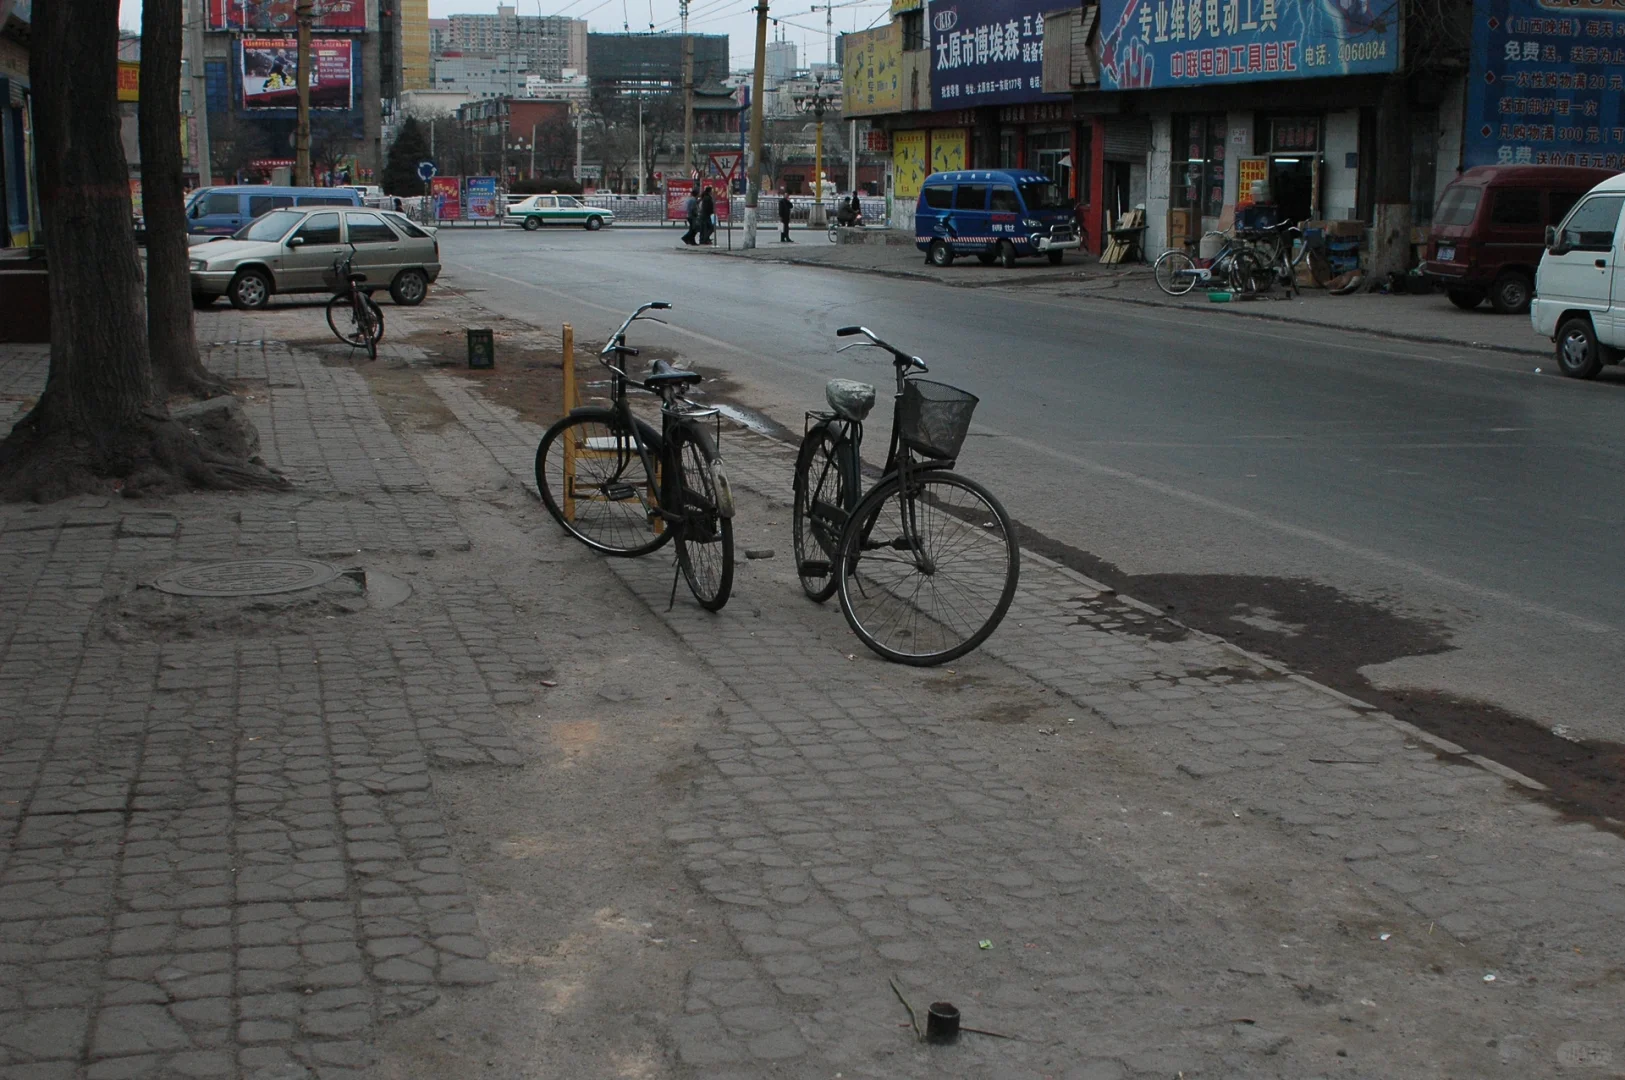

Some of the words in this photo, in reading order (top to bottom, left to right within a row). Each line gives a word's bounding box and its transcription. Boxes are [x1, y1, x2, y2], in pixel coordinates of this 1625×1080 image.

[1023, 13, 1044, 37] 五金
[1138, 0, 1277, 46] 专业维修电动工具
[936, 19, 1019, 71] 太原市博埃森
[1170, 41, 1297, 78] 中联电动工具总汇
[1498, 97, 1598, 117] 送面部护理一次
[720, 158, 731, 169] 让
